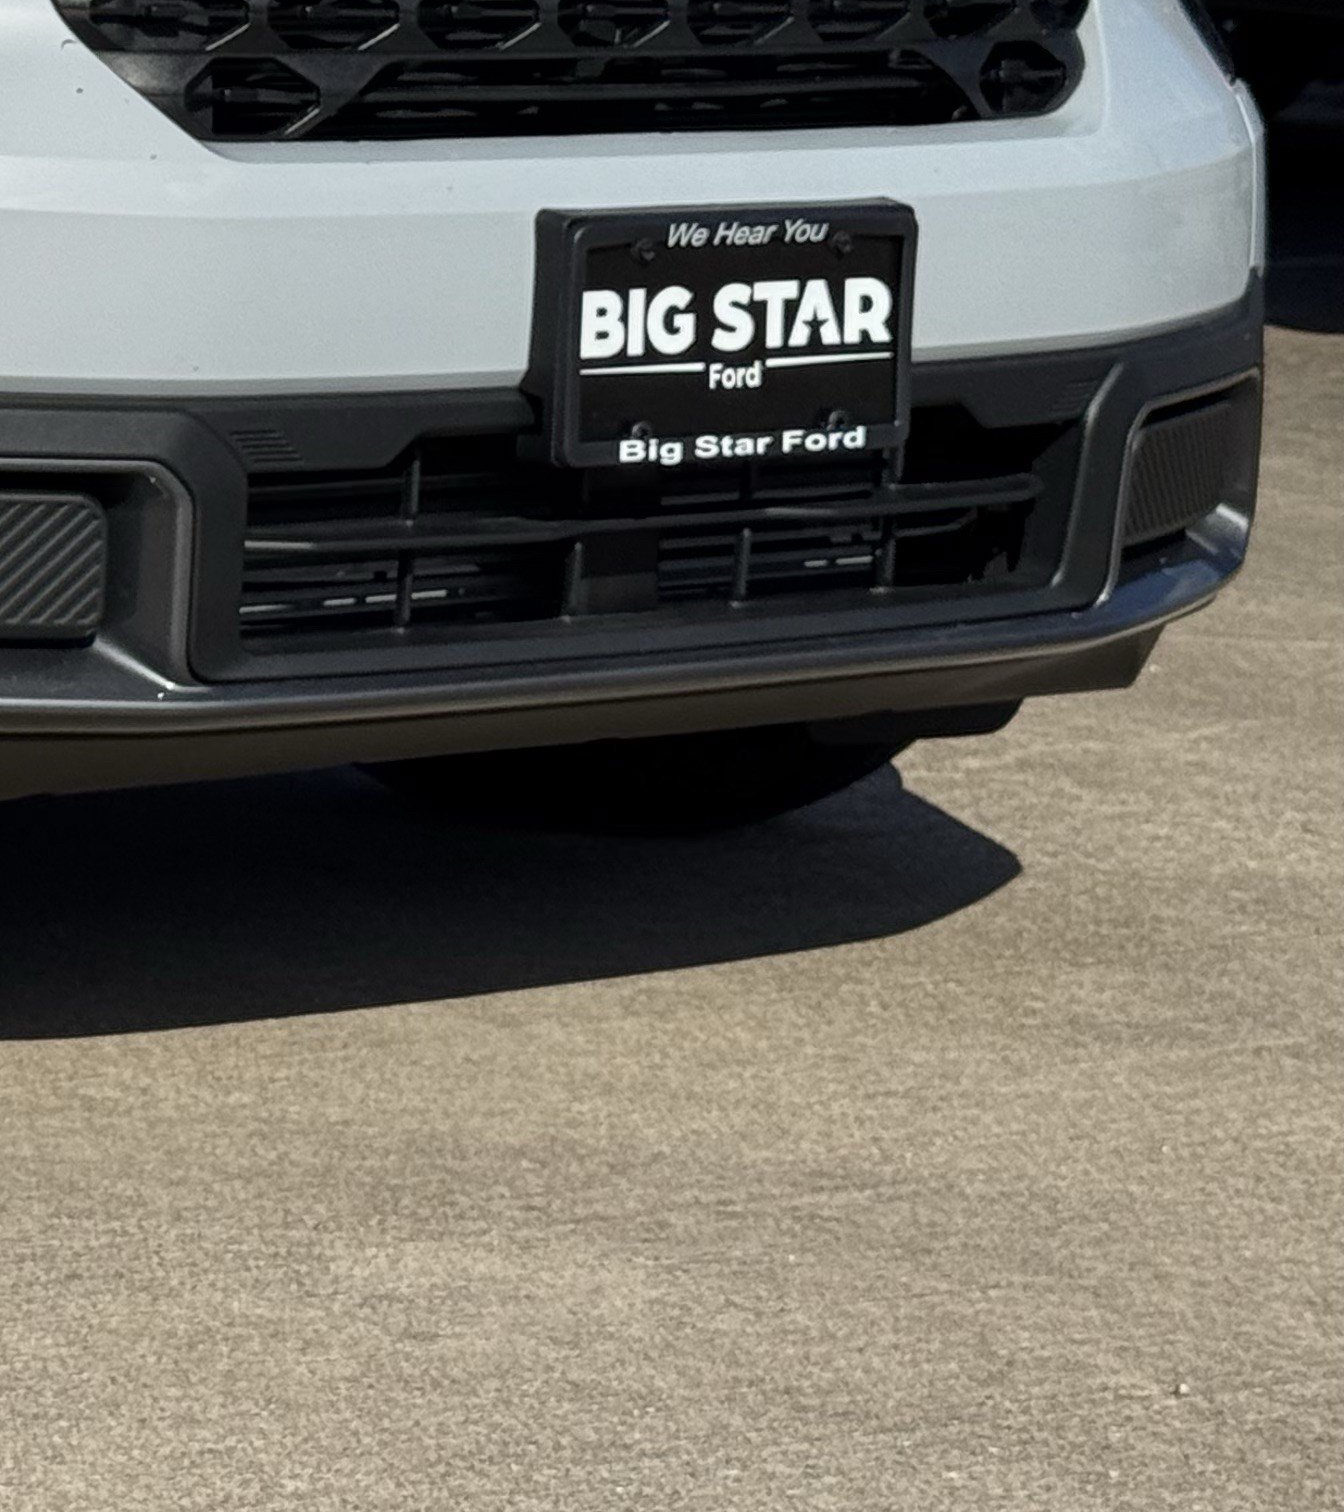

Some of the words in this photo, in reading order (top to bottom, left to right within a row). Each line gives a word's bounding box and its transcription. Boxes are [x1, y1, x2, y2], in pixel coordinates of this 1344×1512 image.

[667, 222, 710, 248] We
[714, 220, 778, 247] Hear
[783, 218, 830, 244] You
[579, 286, 697, 360] BIG
[711, 277, 894, 352] STAR
[708, 361, 763, 390] Ford
[618, 439, 684, 466] Big
[694, 435, 774, 459] Star
[782, 426, 867, 454] Ford
